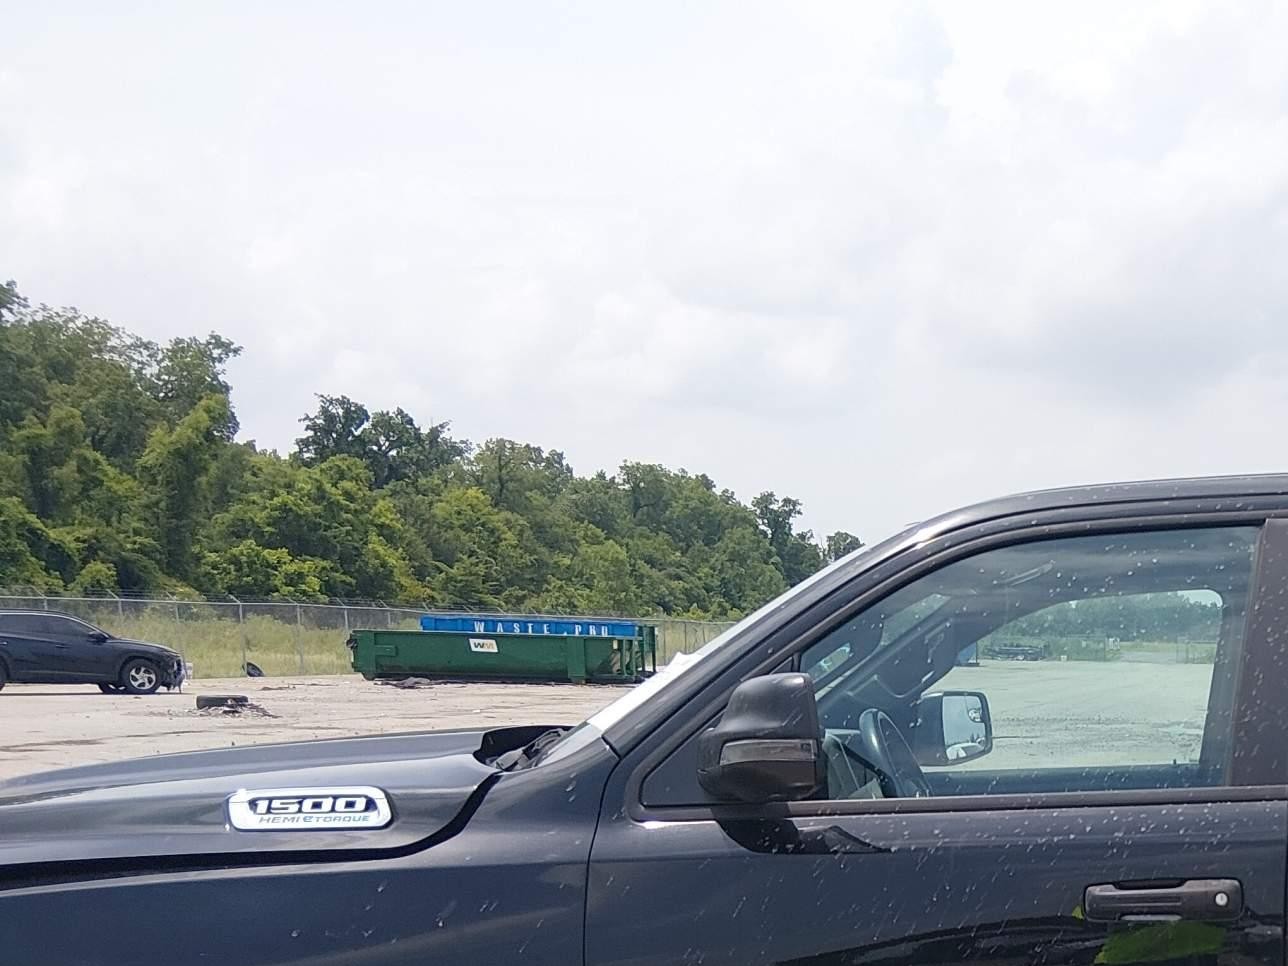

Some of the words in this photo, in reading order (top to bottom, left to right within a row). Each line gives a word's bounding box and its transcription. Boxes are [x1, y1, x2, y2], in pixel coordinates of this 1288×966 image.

[473, 620, 551, 635] WASTE
[254, 796, 368, 815] 1500
[259, 815, 301, 824] HEMI
